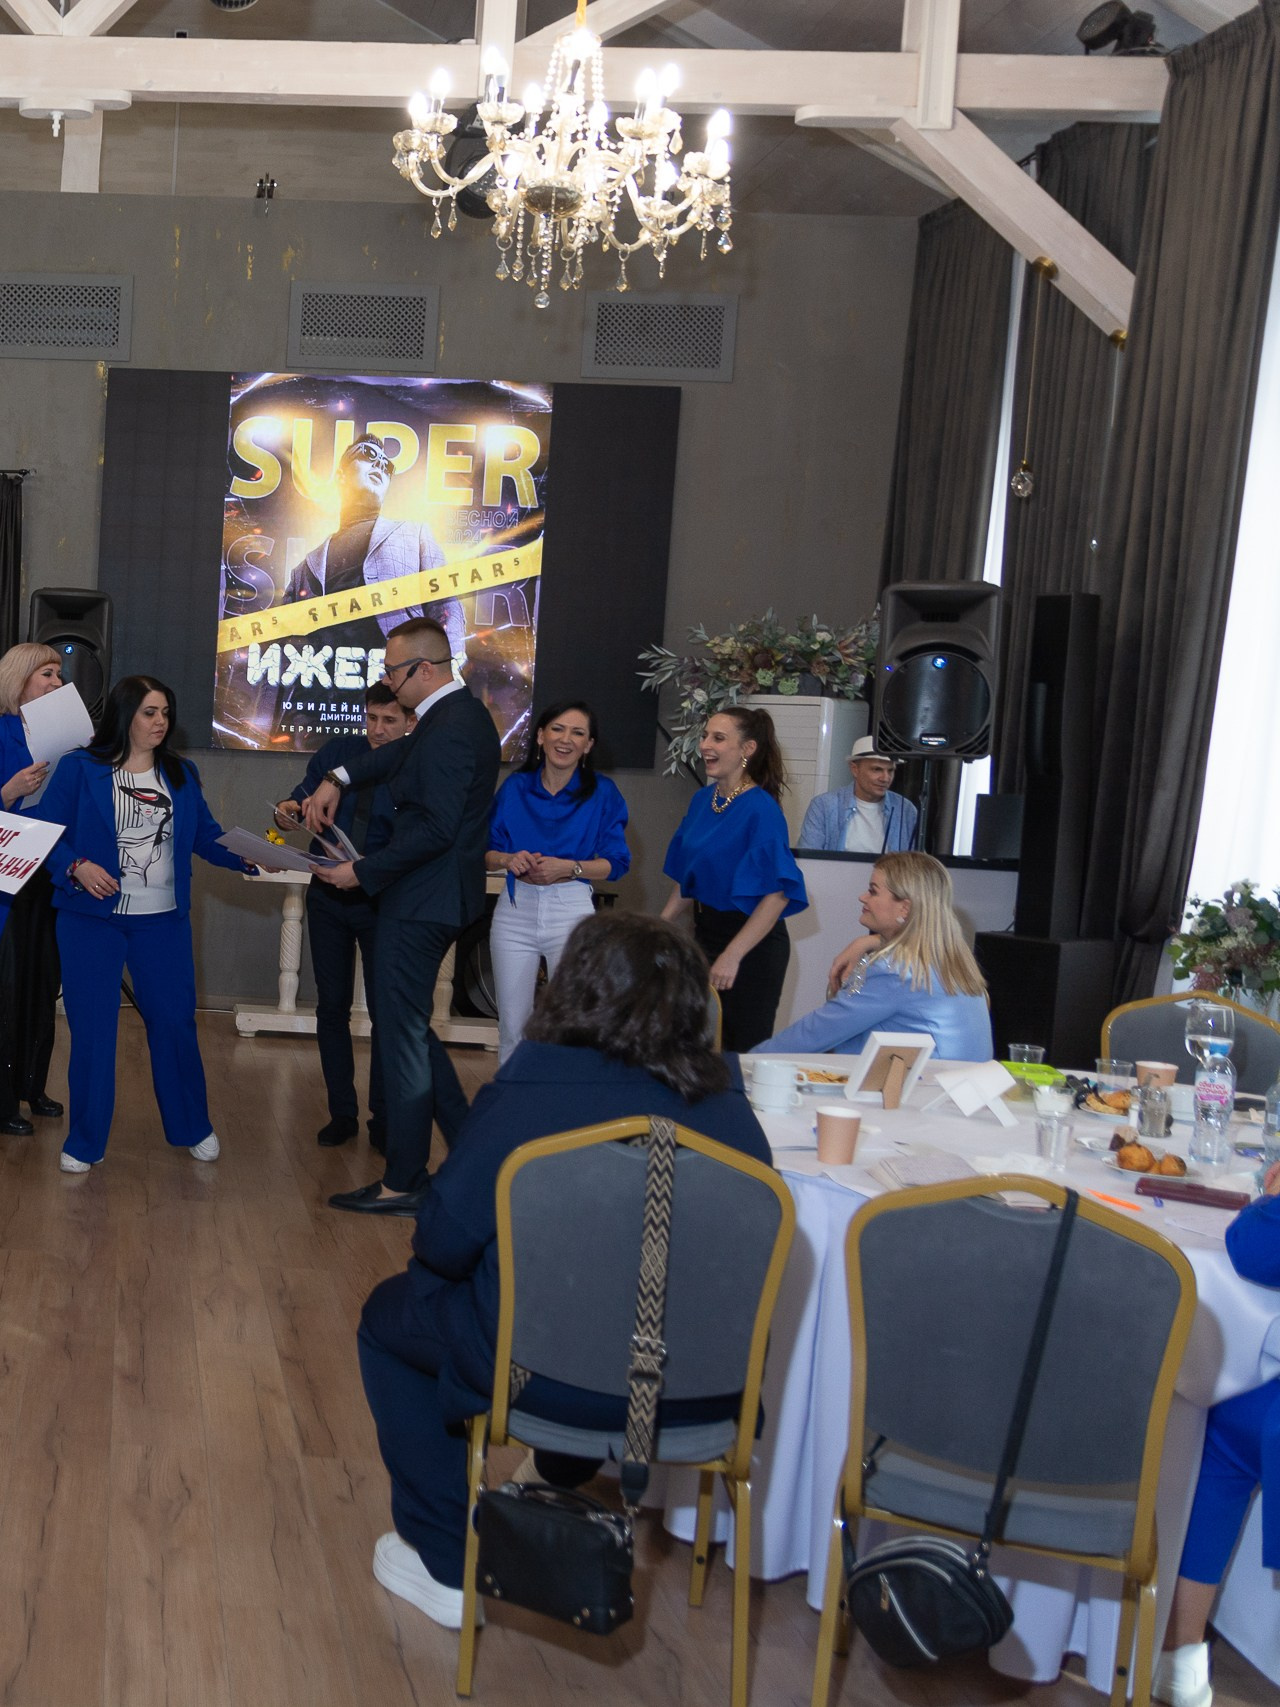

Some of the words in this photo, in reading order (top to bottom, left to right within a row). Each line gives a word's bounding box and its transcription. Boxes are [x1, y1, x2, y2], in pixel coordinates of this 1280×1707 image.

[230, 416, 541, 508] SUPER
[282, 701, 367, 713] ЮБИЛЕЙН
[320, 712, 362, 722] ДМИТРИЯ
[280, 725, 367, 736] ТЕРРИТОРИЯ
